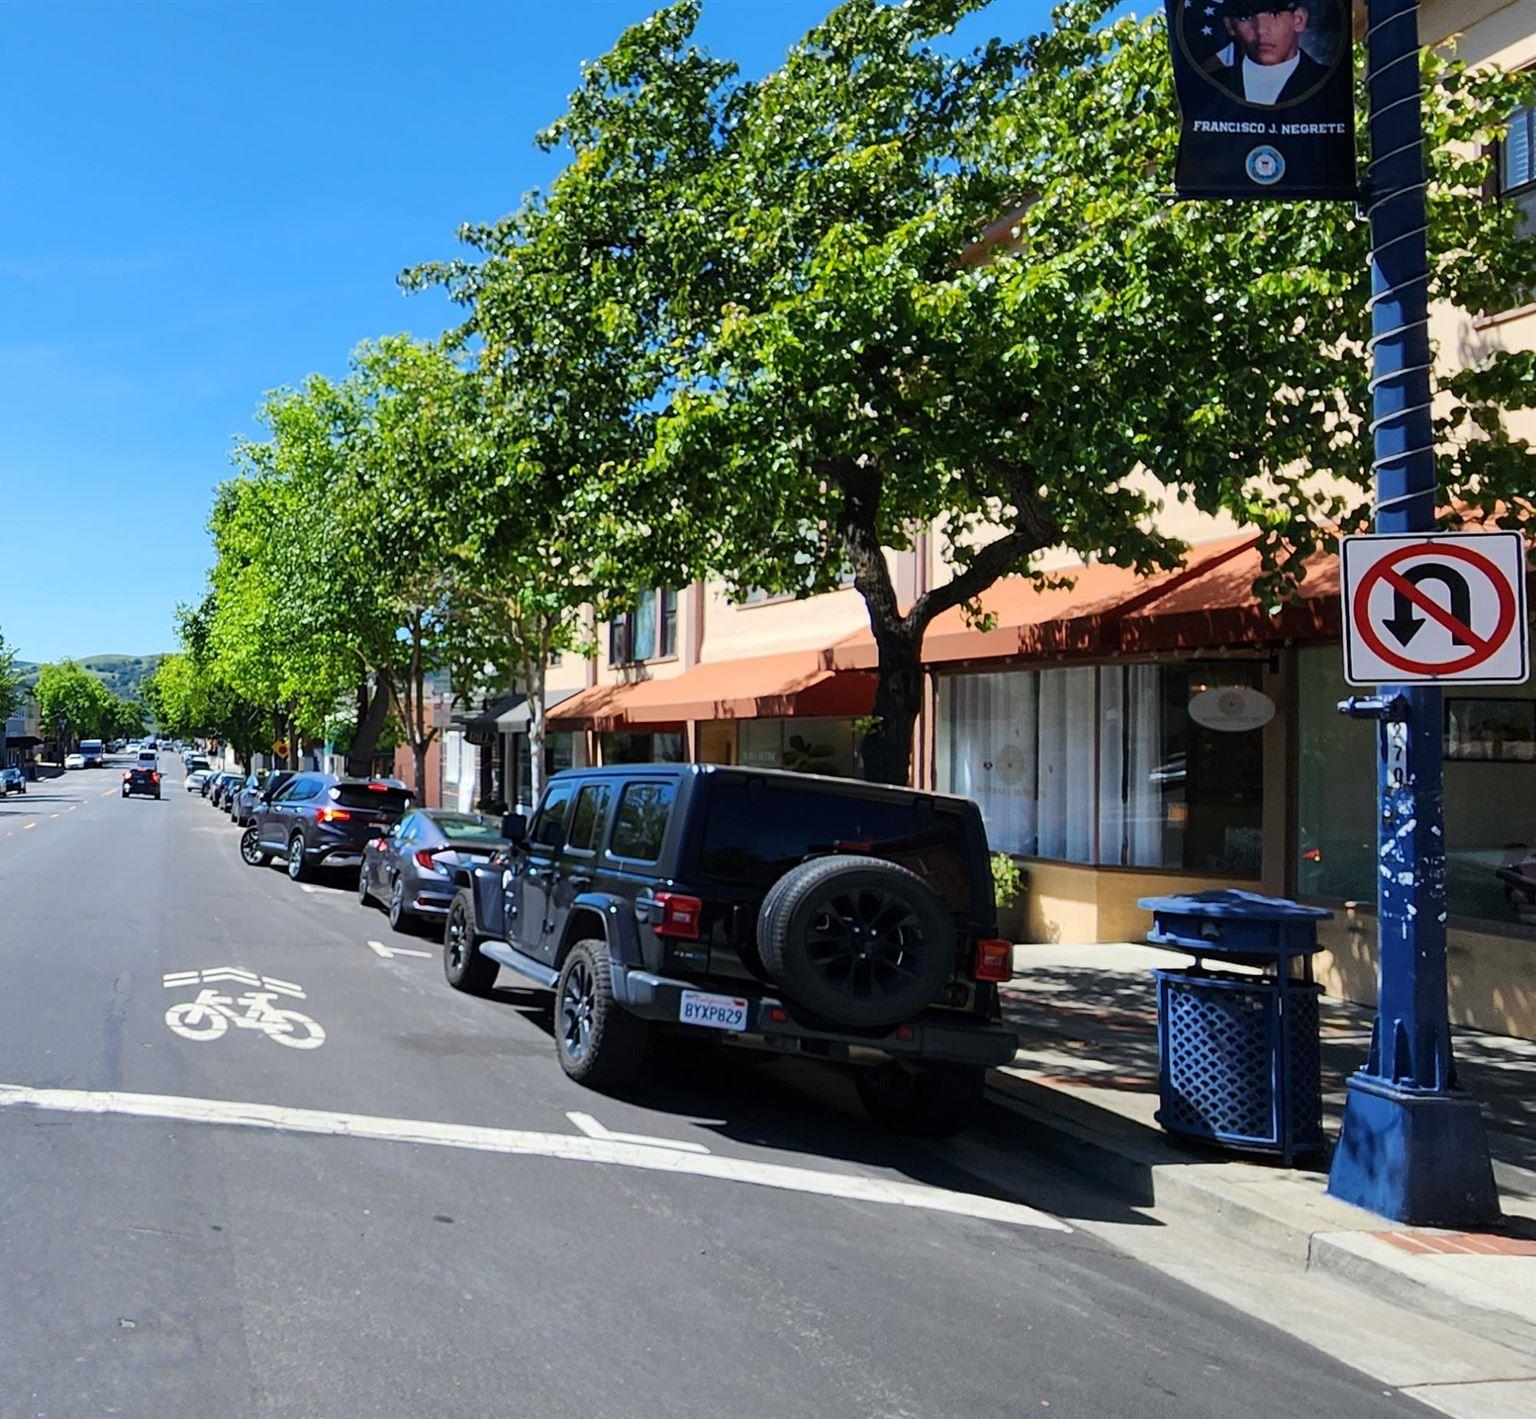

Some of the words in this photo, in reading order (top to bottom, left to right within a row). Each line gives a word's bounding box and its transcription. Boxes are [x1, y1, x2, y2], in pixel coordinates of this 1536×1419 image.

[1193, 121, 1265, 133] FRANCISCO
[1269, 123, 1279, 134] J.
[1281, 123, 1345, 134] NEGRETE
[684, 1003, 743, 1024] 8YXP829
